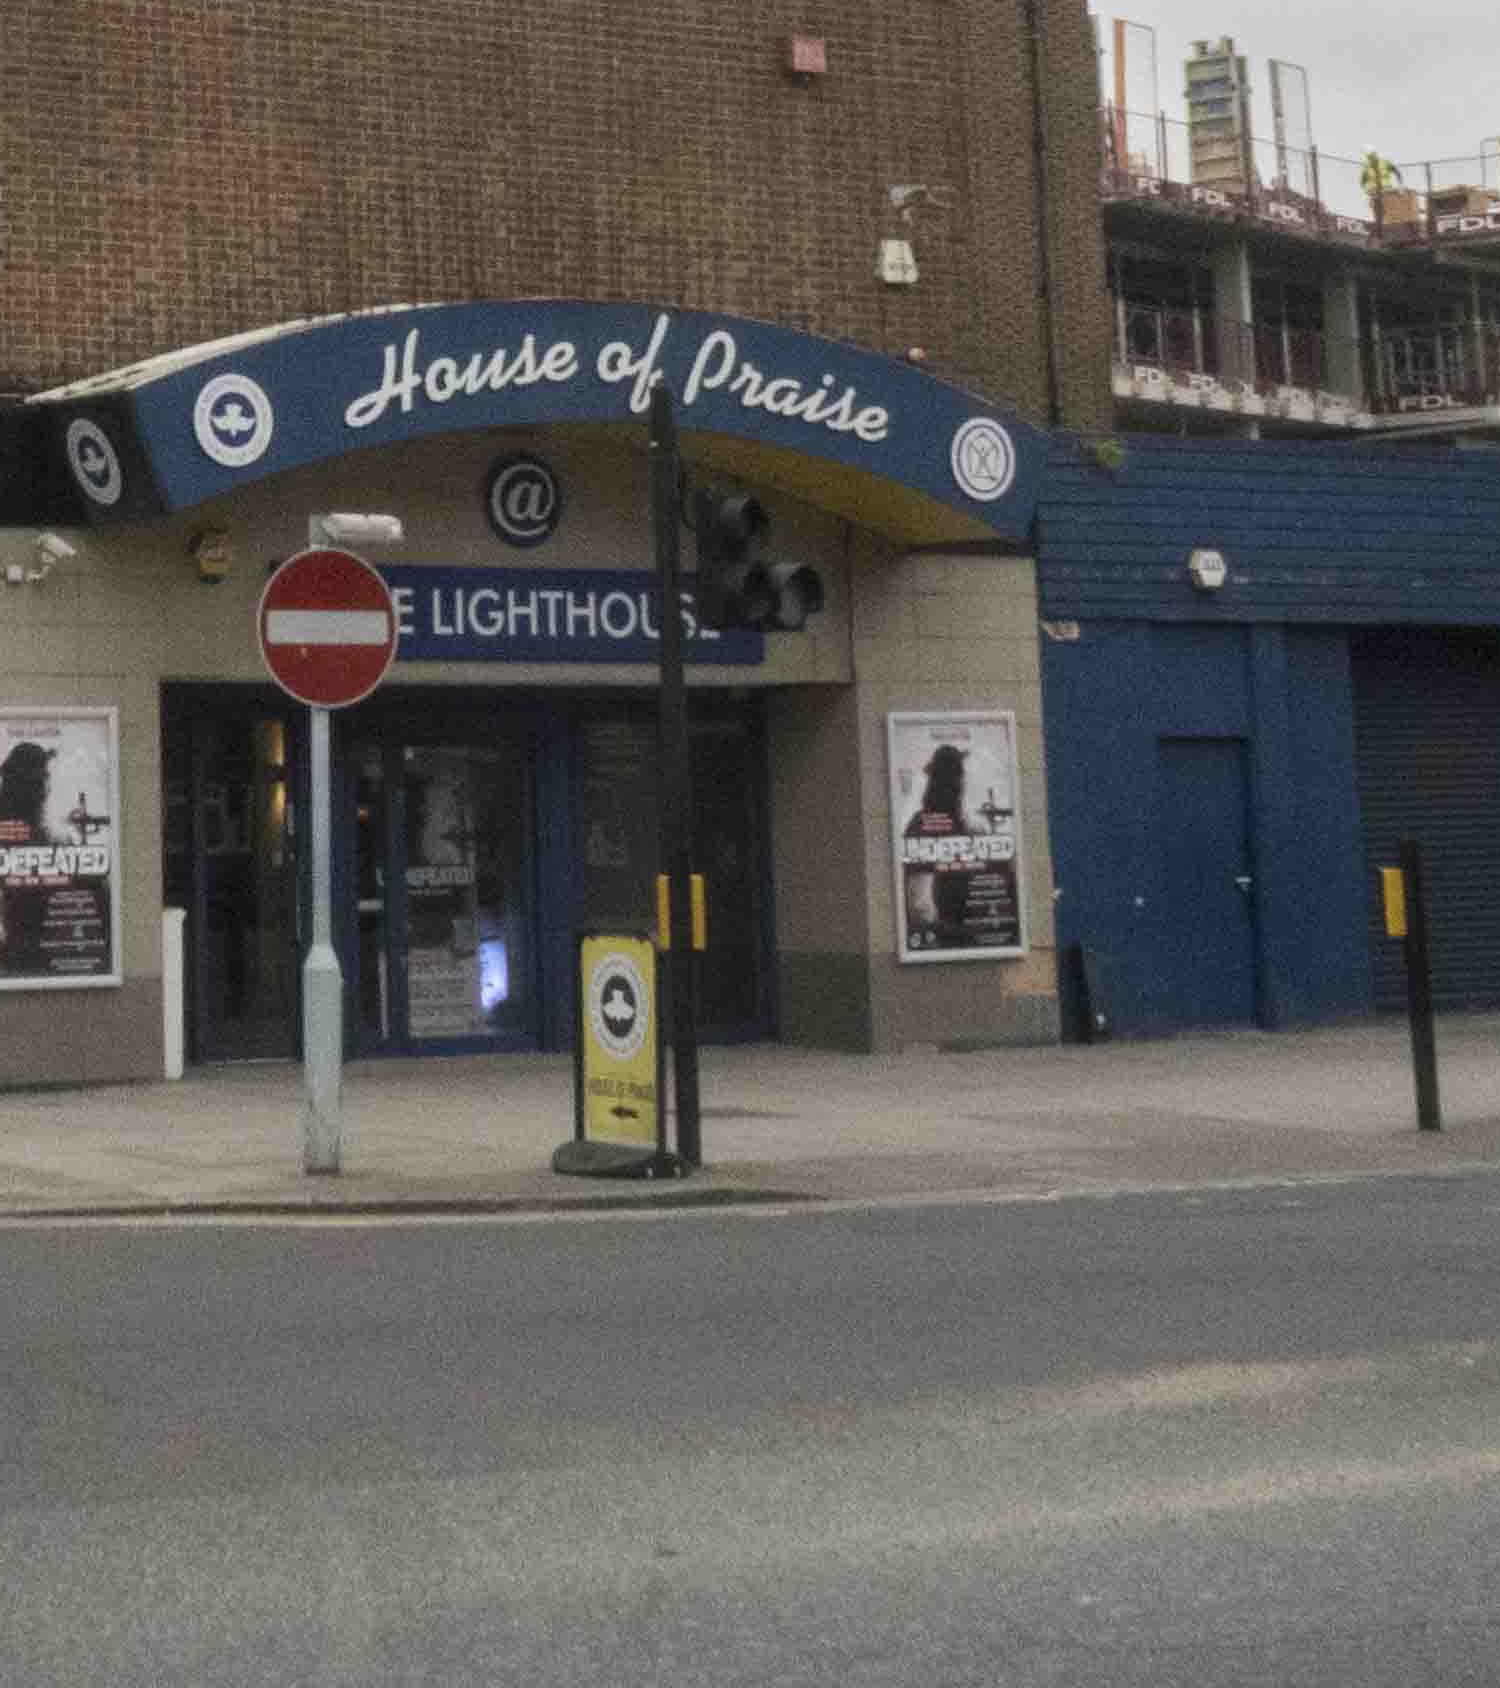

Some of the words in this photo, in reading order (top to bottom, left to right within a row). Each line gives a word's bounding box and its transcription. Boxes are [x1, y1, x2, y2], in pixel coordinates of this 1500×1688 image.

[344, 327, 579, 428] House
[597, 312, 671, 413] of
[683, 329, 889, 442] Praise
